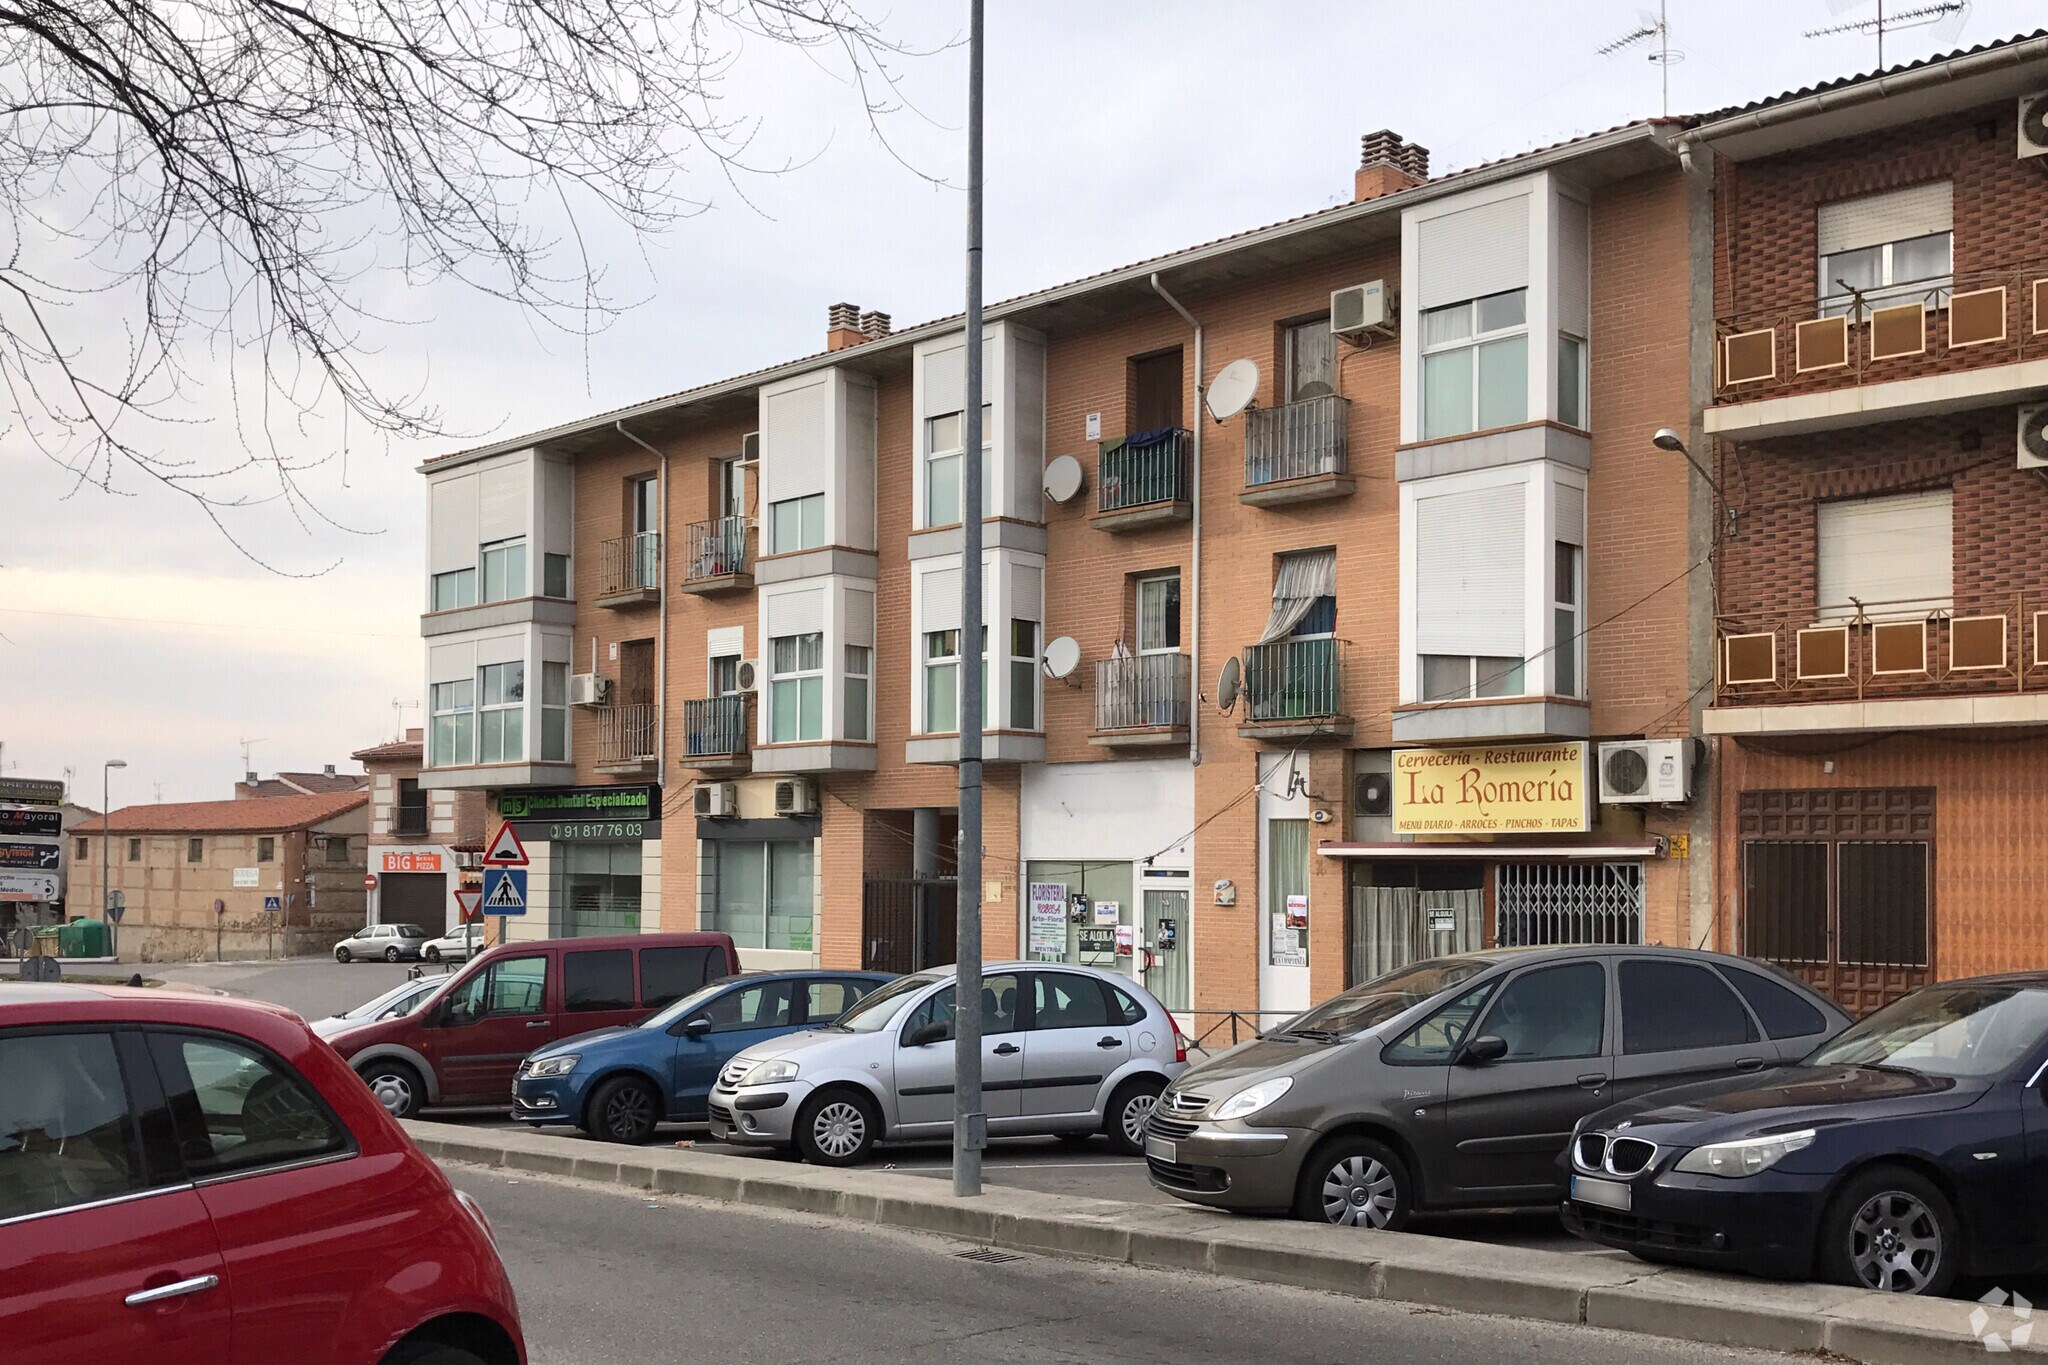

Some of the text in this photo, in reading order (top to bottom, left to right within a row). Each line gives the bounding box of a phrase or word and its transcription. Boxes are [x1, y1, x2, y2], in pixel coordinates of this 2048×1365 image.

[1398, 747, 1577, 768] Cervecería Restaurante
[1403, 767, 1573, 817] La Romería
[558, 793, 585, 808] Dental
[586, 792, 647, 809] Especializada
[13, 812, 58, 821] Mayoral
[1424, 819, 1453, 830] DIARIO
[1460, 819, 1498, 829] ARROCES
[1506, 818, 1543, 828] PINCHOS
[1551, 817, 1578, 828] TAPAS
[564, 823, 643, 838] 91 817 76 03
[388, 856, 411, 870] BIG
[416, 862, 434, 870] PIZZA
[1079, 930, 1088, 941] SE
[1089, 930, 1114, 942] ALQUILA
